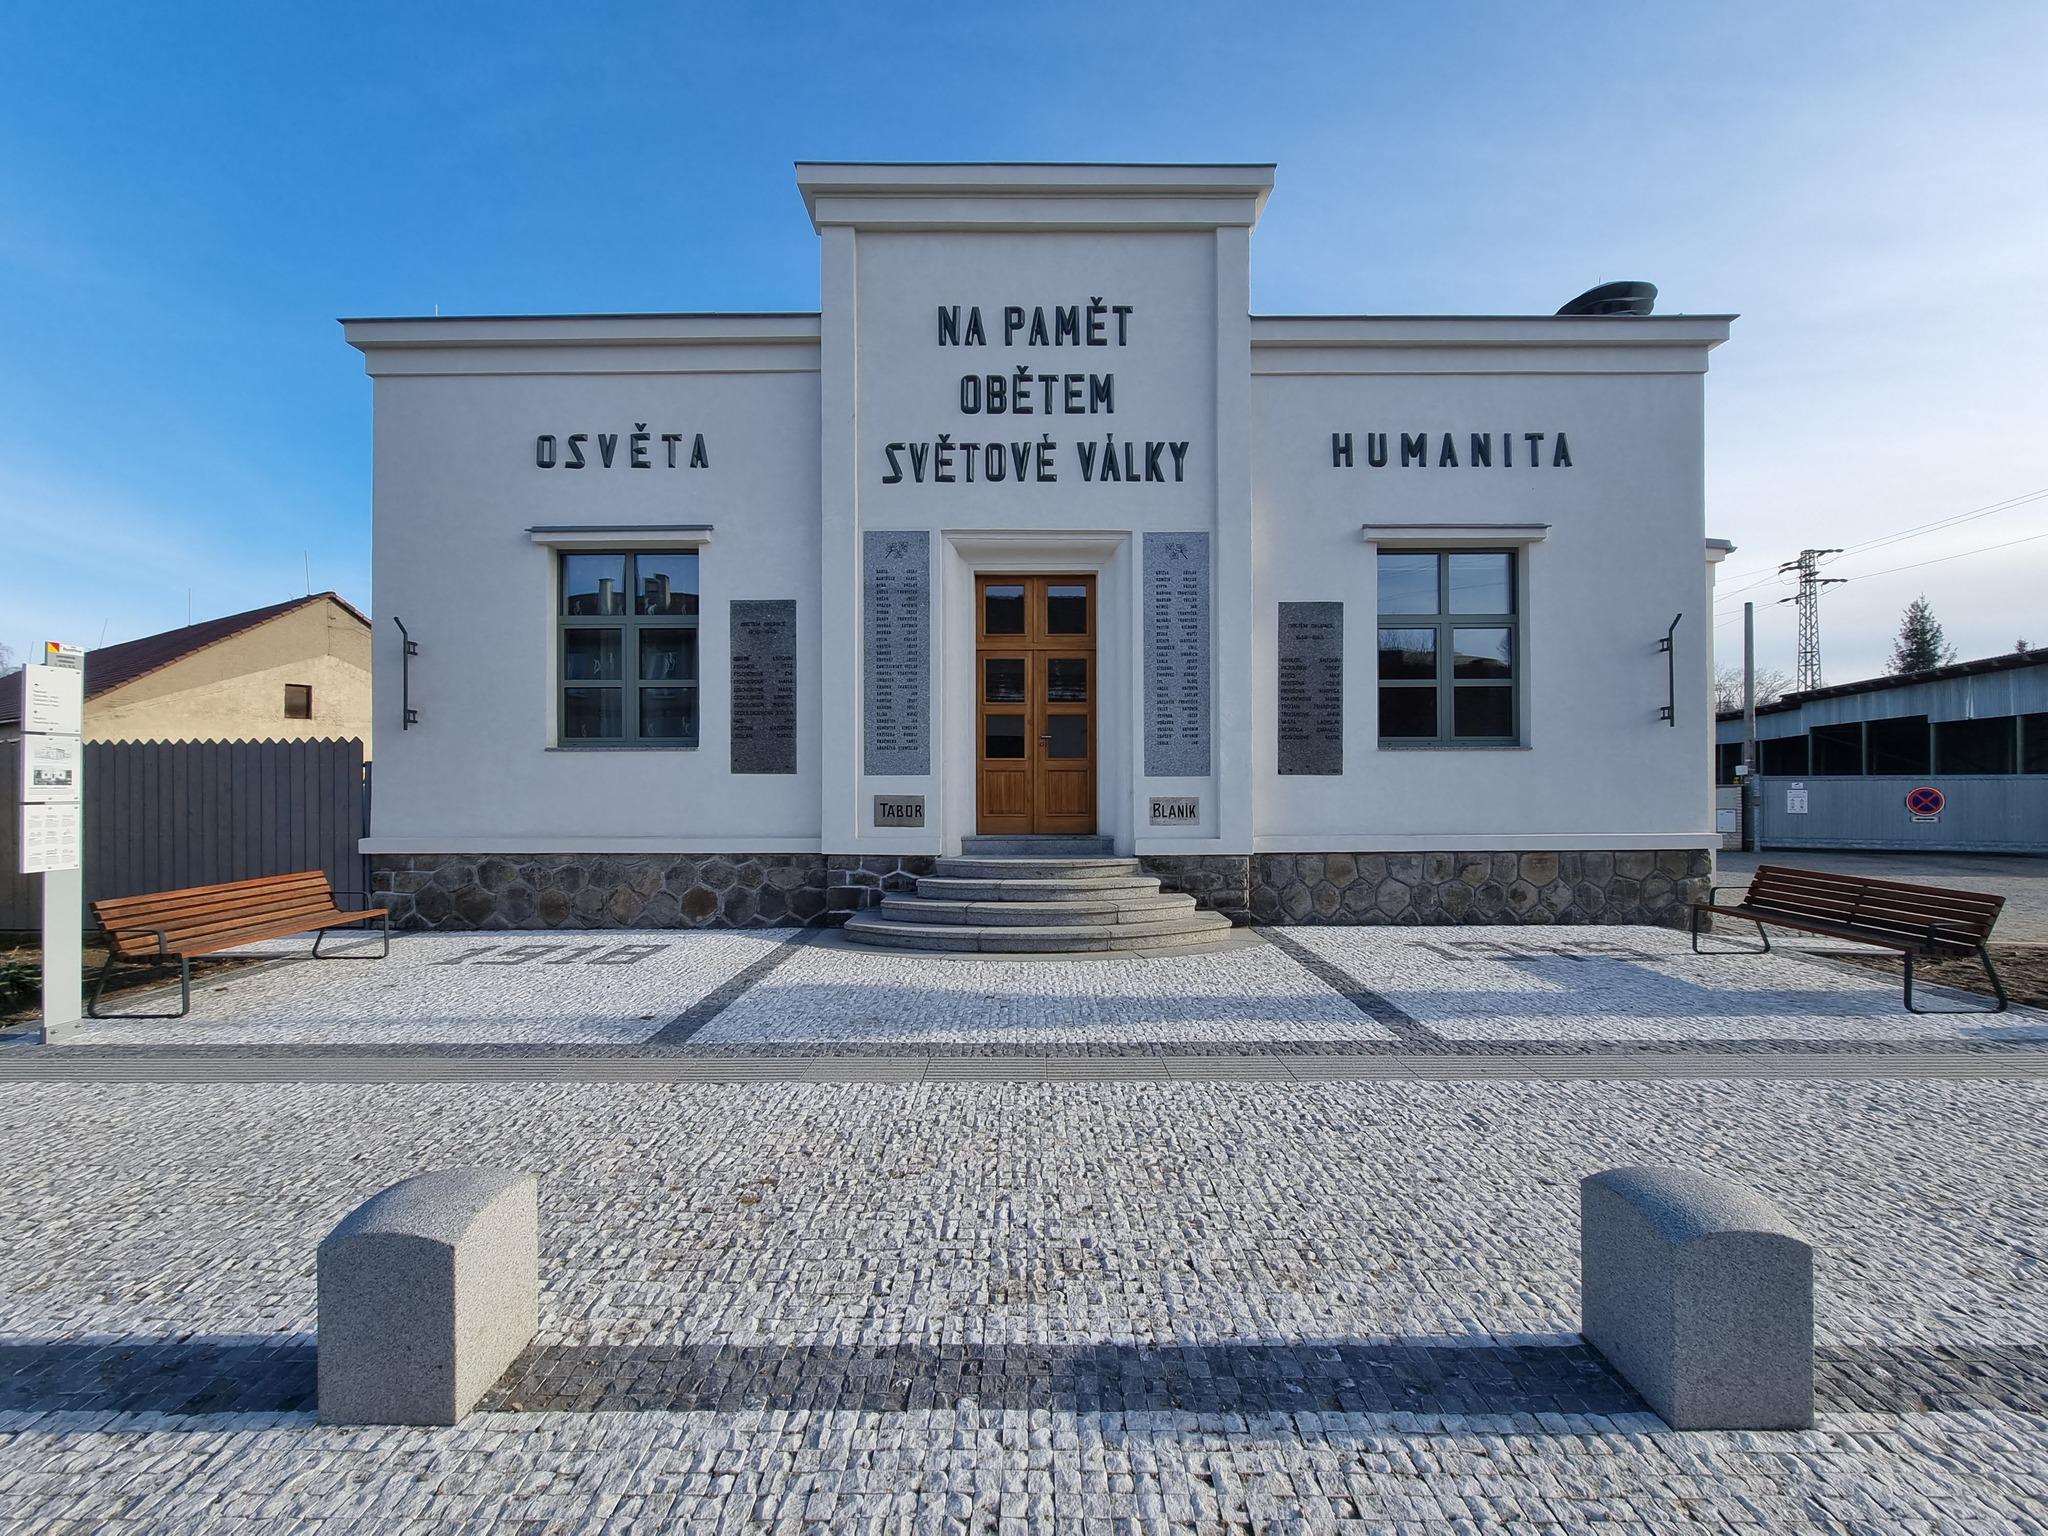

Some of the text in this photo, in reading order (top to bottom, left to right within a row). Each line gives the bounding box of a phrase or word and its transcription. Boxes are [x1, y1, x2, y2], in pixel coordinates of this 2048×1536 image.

[938, 296, 1134, 347] NA PAMĚT
[960, 365, 1114, 415] OBĚTEM
[536, 422, 710, 470] OSVĚTA
[882, 433, 1190, 484] SVĚTOVÉ VÁLKY
[1331, 431, 1574, 468] HUMANITA
